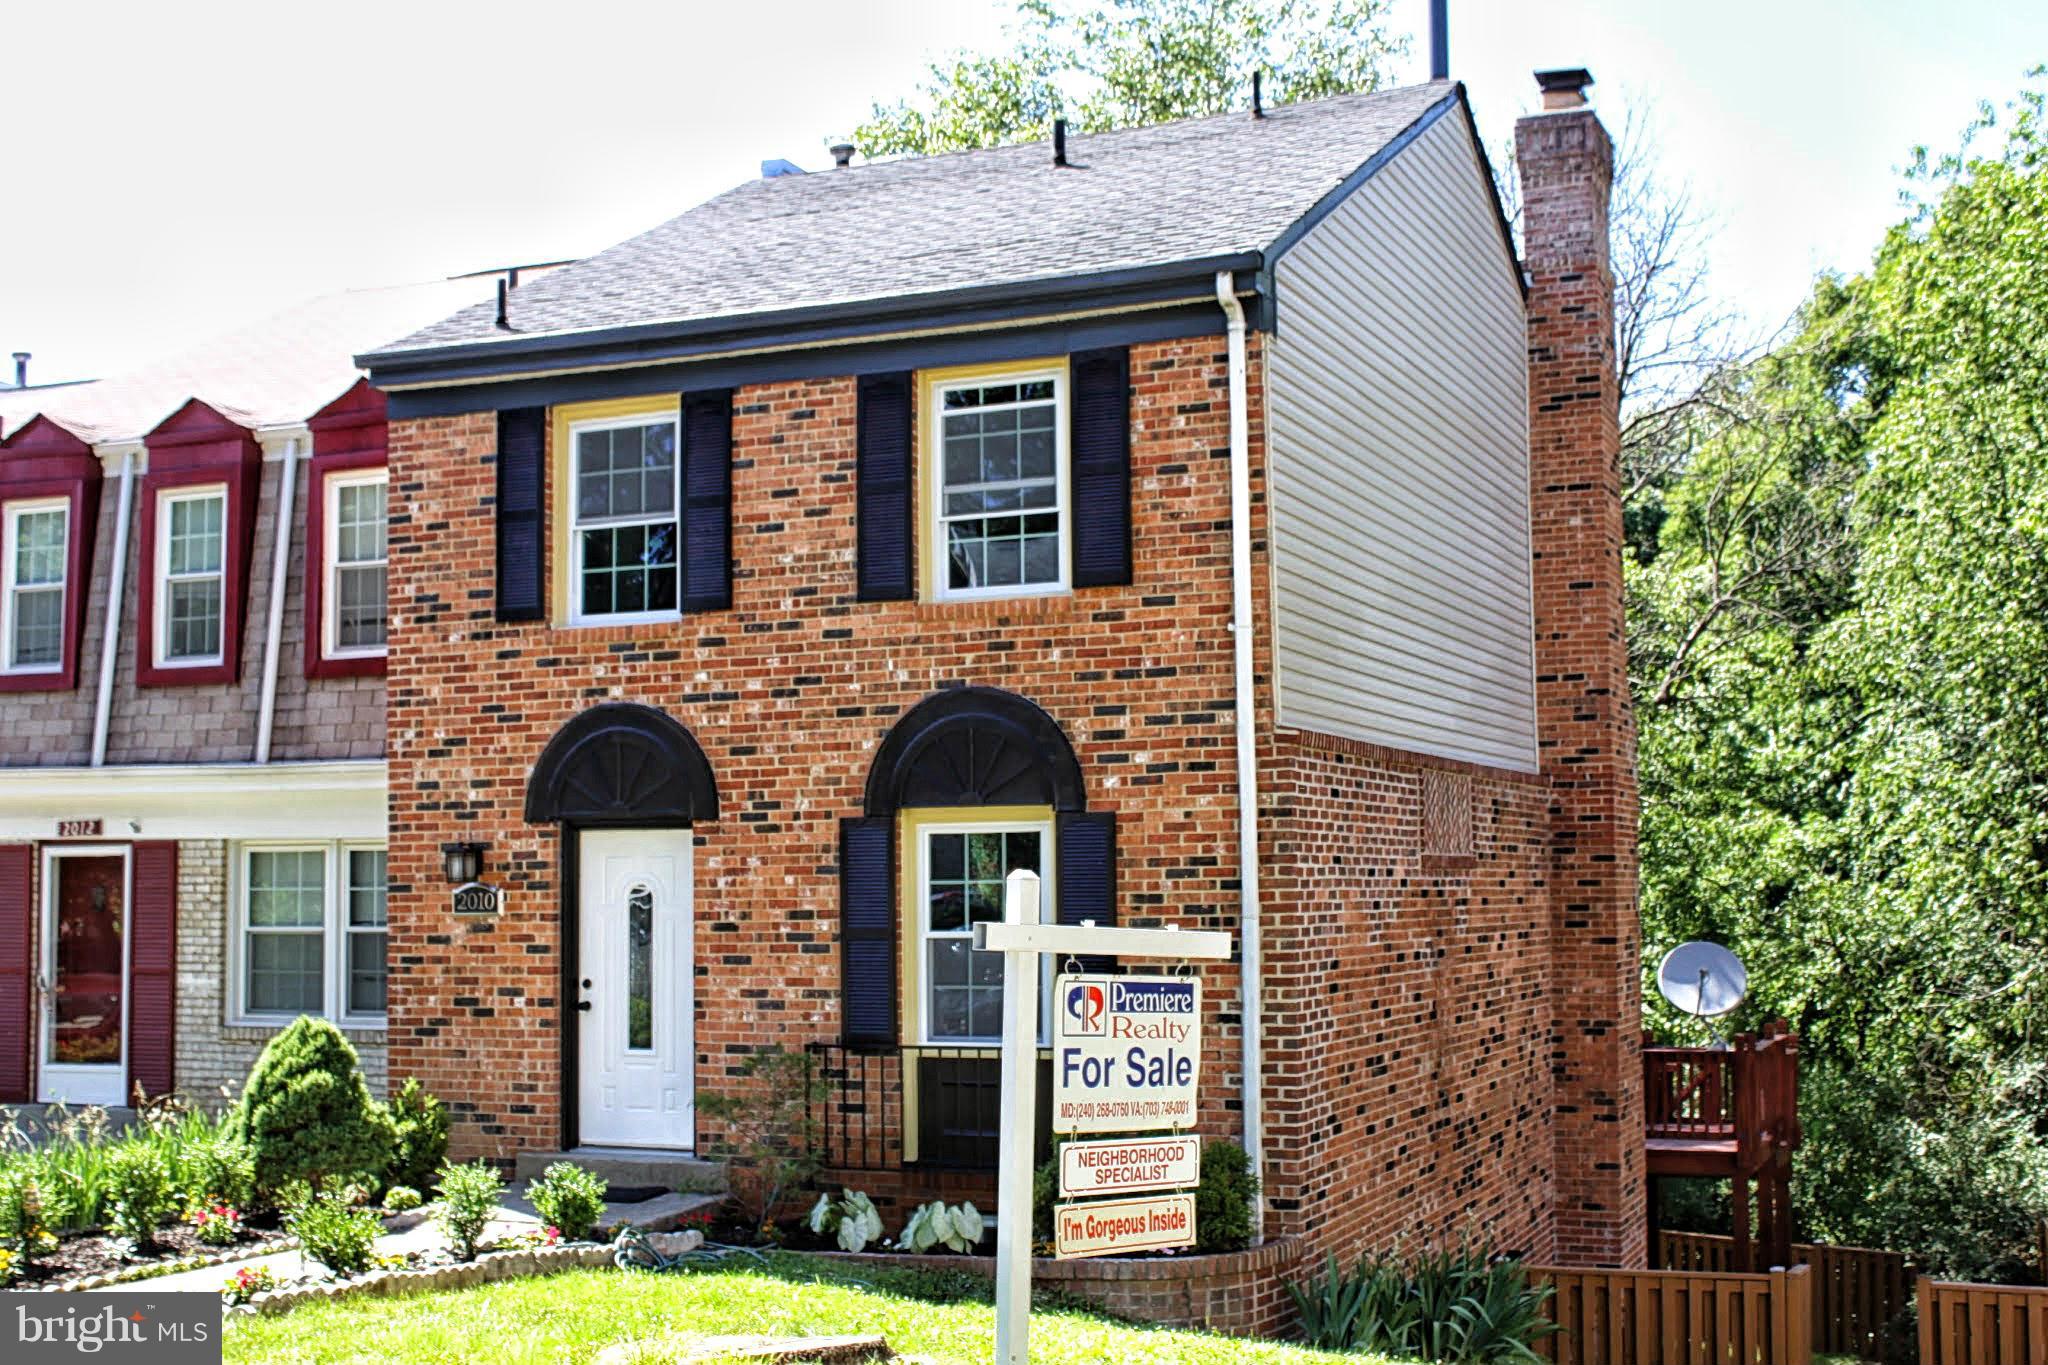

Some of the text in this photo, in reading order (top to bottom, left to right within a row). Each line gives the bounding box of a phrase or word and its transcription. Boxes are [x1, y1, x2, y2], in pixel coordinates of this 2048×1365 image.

[63, 821, 95, 835] 2012
[457, 892, 495, 910] 2010
[1111, 982, 1192, 1012] Premiere
[1111, 1015, 1191, 1043] Realty
[1062, 1046, 1192, 1088] For Sale
[1078, 1146, 1185, 1168] NEIGHBORHOOD
[1095, 1164, 1169, 1185] SPECIALIST
[1063, 1207, 1186, 1242] I'm Gorgeous Inside
